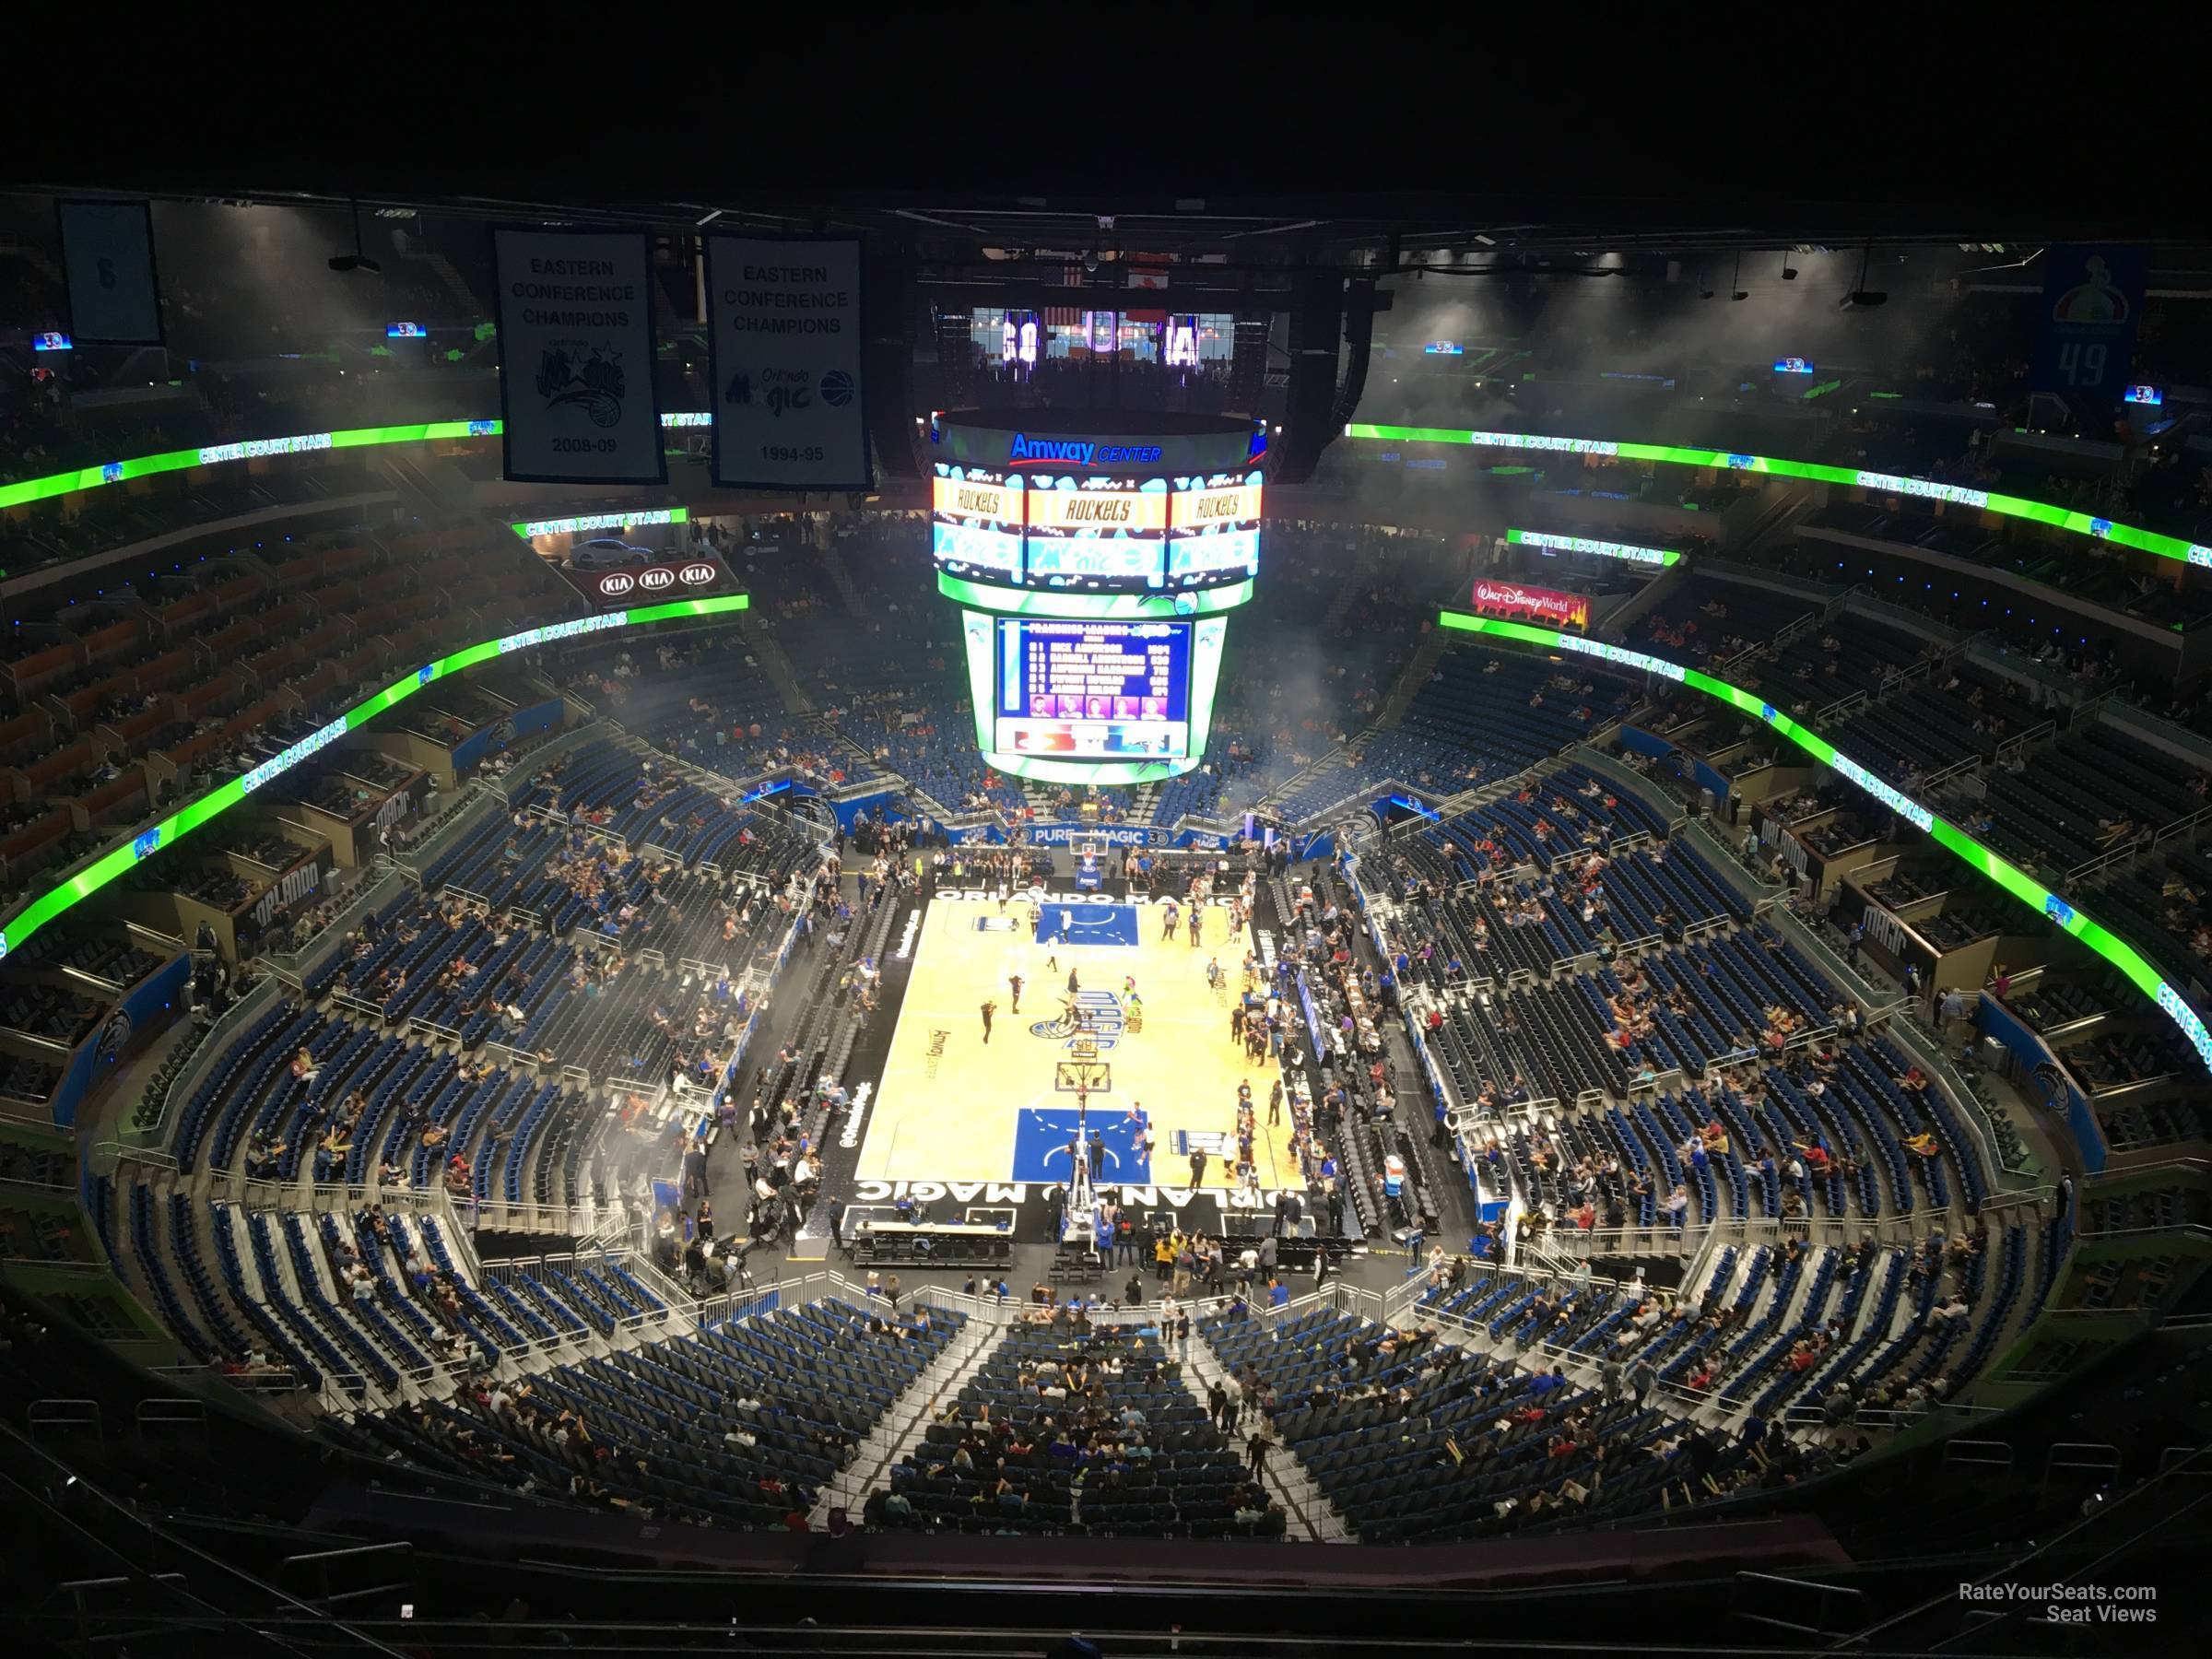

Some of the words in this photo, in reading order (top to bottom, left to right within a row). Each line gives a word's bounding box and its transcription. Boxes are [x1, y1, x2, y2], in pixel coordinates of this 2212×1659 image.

[531, 258, 614, 276] EASTERN
[744, 265, 827, 283] EASTERN
[512, 282, 635, 302] CONFERENCE
[724, 289, 848, 309] CONFERENCE
[523, 308, 629, 328] CHAMPIONS
[733, 316, 841, 335] CHAMPIONS
[2058, 341, 2108, 388] 49
[199, 442, 244, 465] CENTER
[246, 437, 291, 457] COURT
[291, 432, 333, 452] STARS
[552, 437, 618, 454] 2008-09
[760, 445, 825, 462] 1994-95
[1010, 433, 1095, 466] Amway
[1098, 446, 1162, 463] CENTER
[1472, 431, 1524, 448] CENTER
[1525, 435, 1573, 452] COURT
[1574, 440, 1618, 455] STARS
[1856, 470, 1905, 492] CENTER
[1906, 477, 1951, 500] COURT
[1951, 485, 1988, 507] STARS
[1065, 499, 1132, 522] ROCKETS
[526, 521, 579, 536] CENTER
[581, 514, 626, 531] COURT
[626, 510, 672, 526] STARS
[1520, 531, 1573, 550] CENTER
[1574, 537, 1622, 557] COURT
[1622, 545, 1665, 564] STARS
[606, 578, 628, 591] KIA
[645, 572, 666, 585] KIA
[686, 568, 708, 581] KIA
[1542, 596, 1568, 612] World
[499, 629, 542, 653] CENTER
[543, 619, 585, 641] COURT
[586, 611, 628, 632] STARS
[1558, 633, 1607, 658] CENTER
[1607, 644, 1651, 670] COURT
[1651, 657, 1686, 682] STARS
[243, 755, 285, 794] CENTER
[284, 734, 317, 768] COURT
[317, 716, 347, 747] STARS
[1833, 751, 1867, 789] CENTER
[1866, 773, 1900, 810] COURT
[1899, 795, 1934, 833] STARS
[376, 791, 410, 834] MAGIC
[1035, 829, 1076, 842] PURE
[1091, 830, 1144, 844] MAGIC
[1147, 830, 1170, 846] 30
[1760, 818, 1808, 875] ORLANDO
[256, 862, 319, 927] ORLANDO
[935, 890, 1115, 904] ORLANDO
[1863, 905, 1907, 958] MAGIC
[2157, 982, 2206, 1048] CENTER
[925, 1030, 951, 1059] Amway
[855, 1181, 1027, 1204] MAGIC
